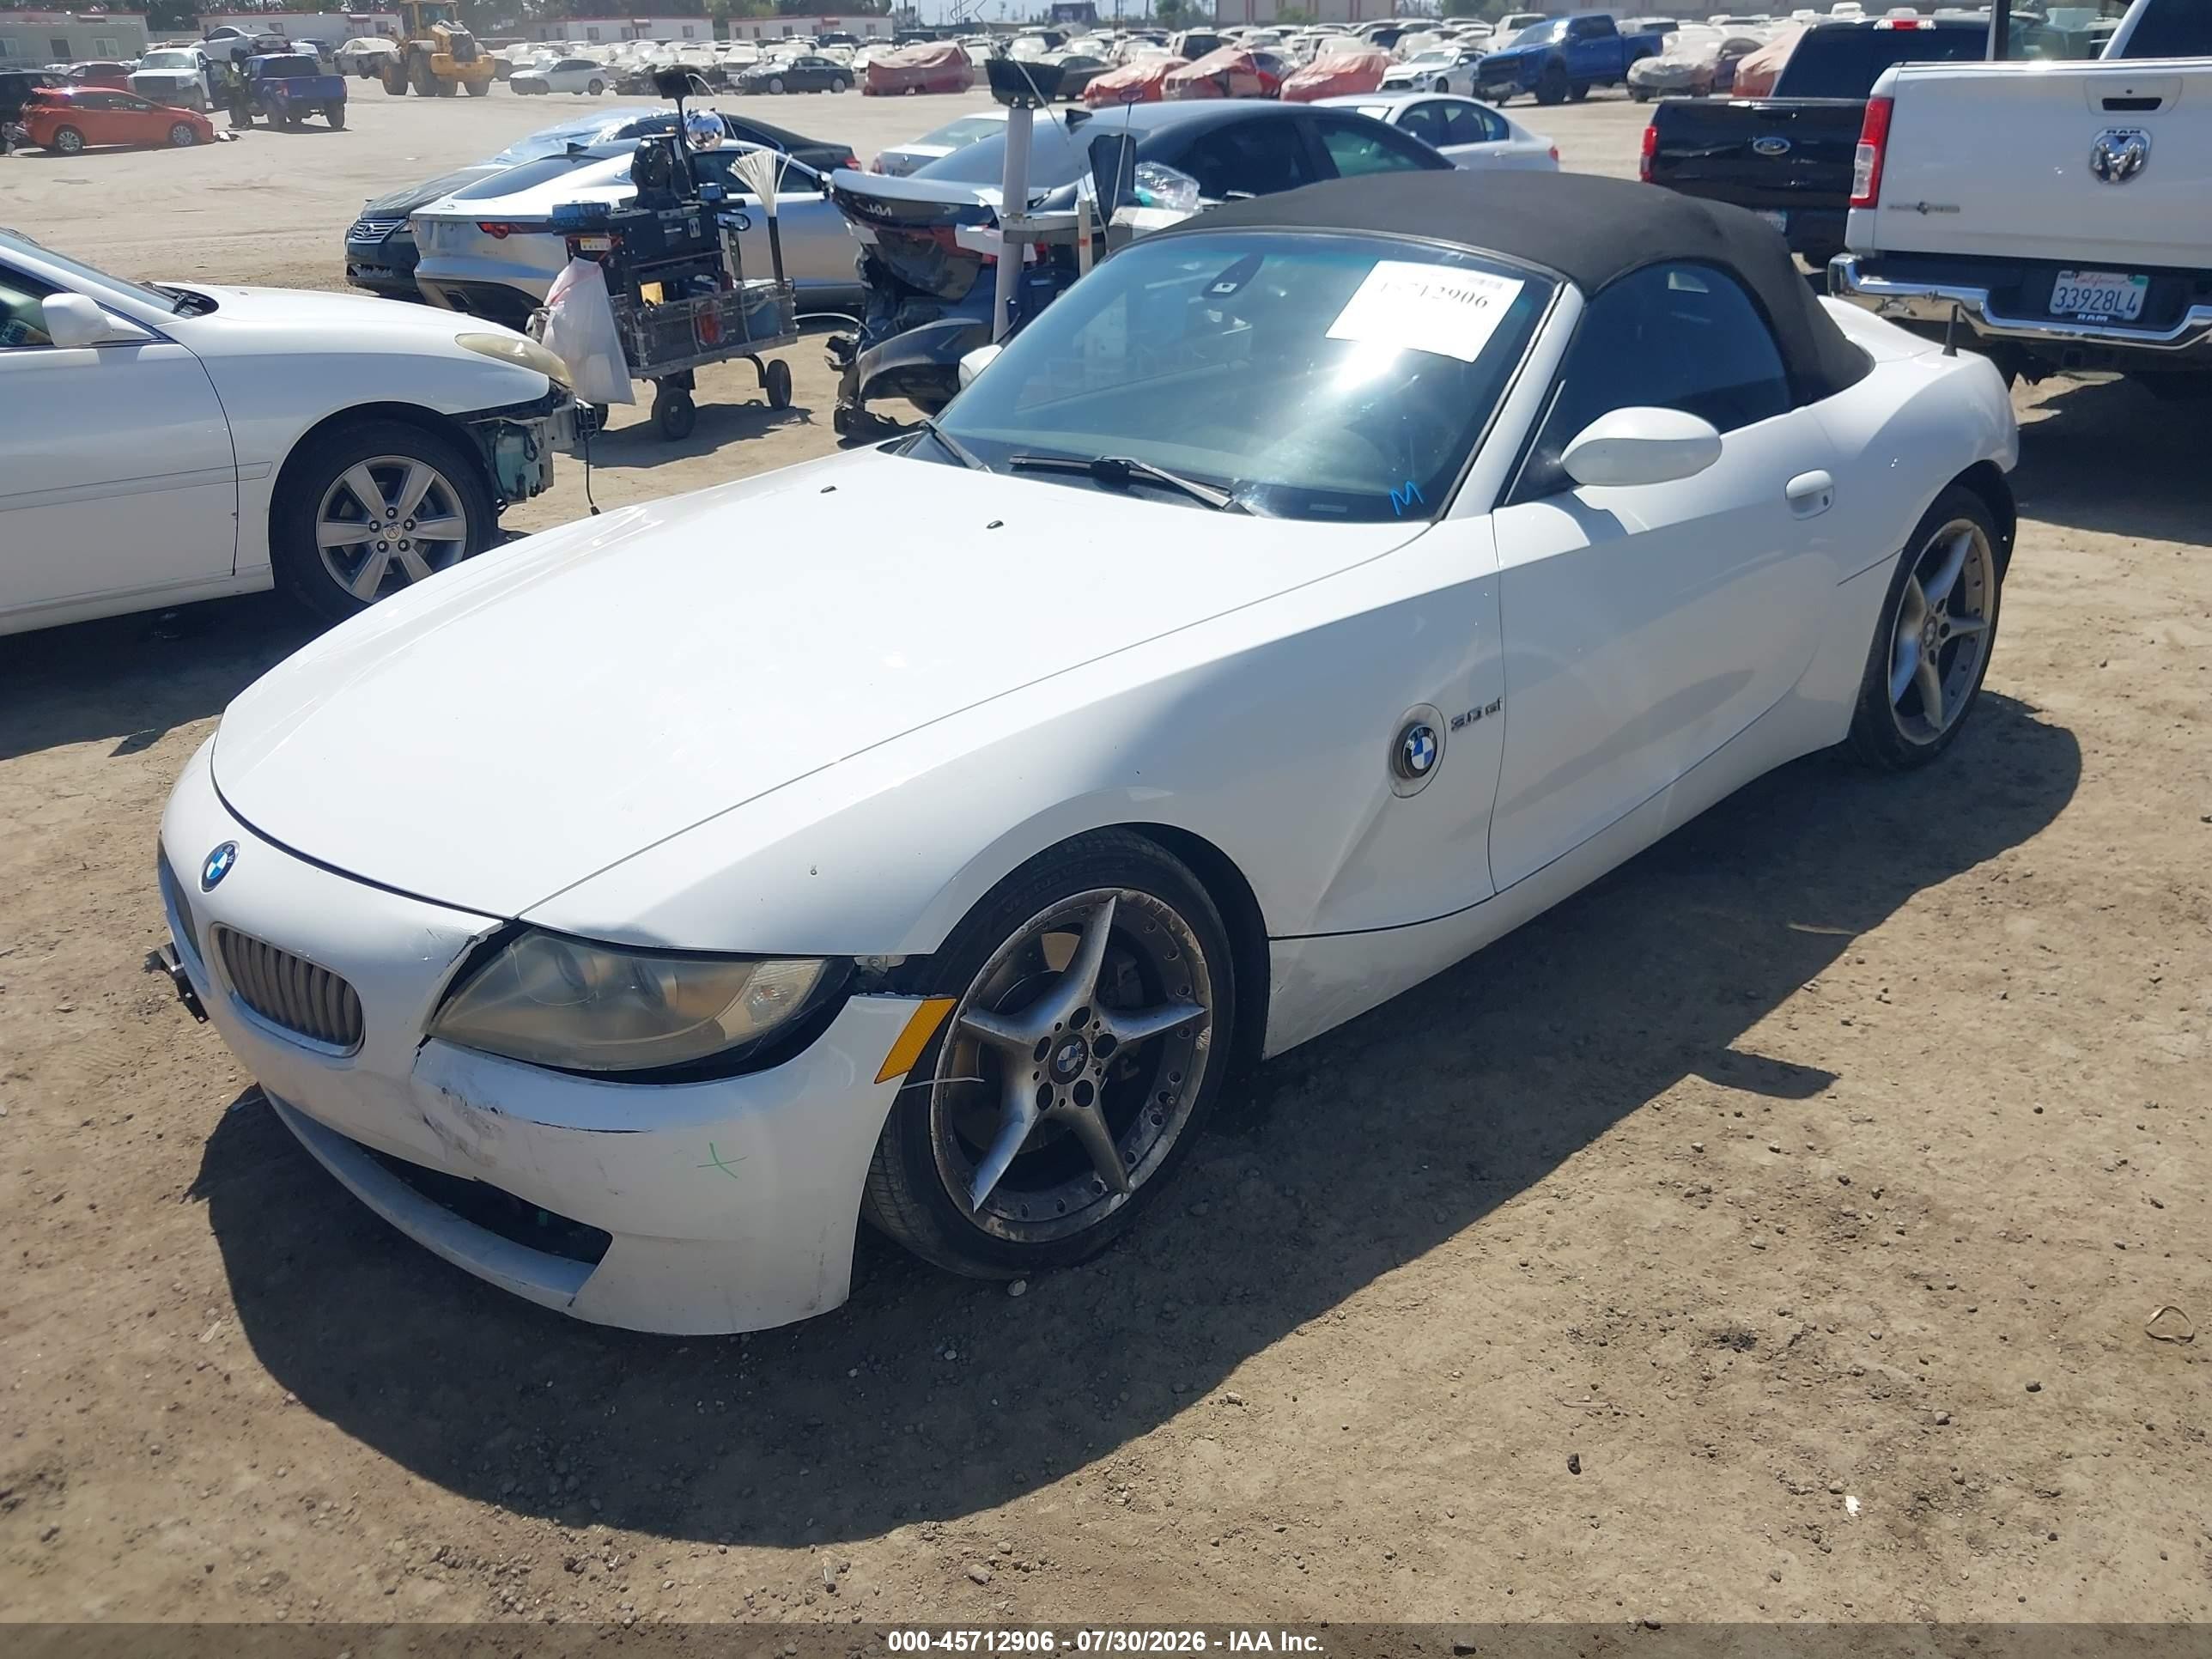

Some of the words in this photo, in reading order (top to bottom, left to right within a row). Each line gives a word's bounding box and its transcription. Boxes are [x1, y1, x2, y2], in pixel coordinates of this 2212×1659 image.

[1379, 281, 1492, 310] 12906
[2054, 286, 2137, 314] 33928L4
[2076, 313, 2109, 323] RAM
[1389, 480, 1425, 516] M
